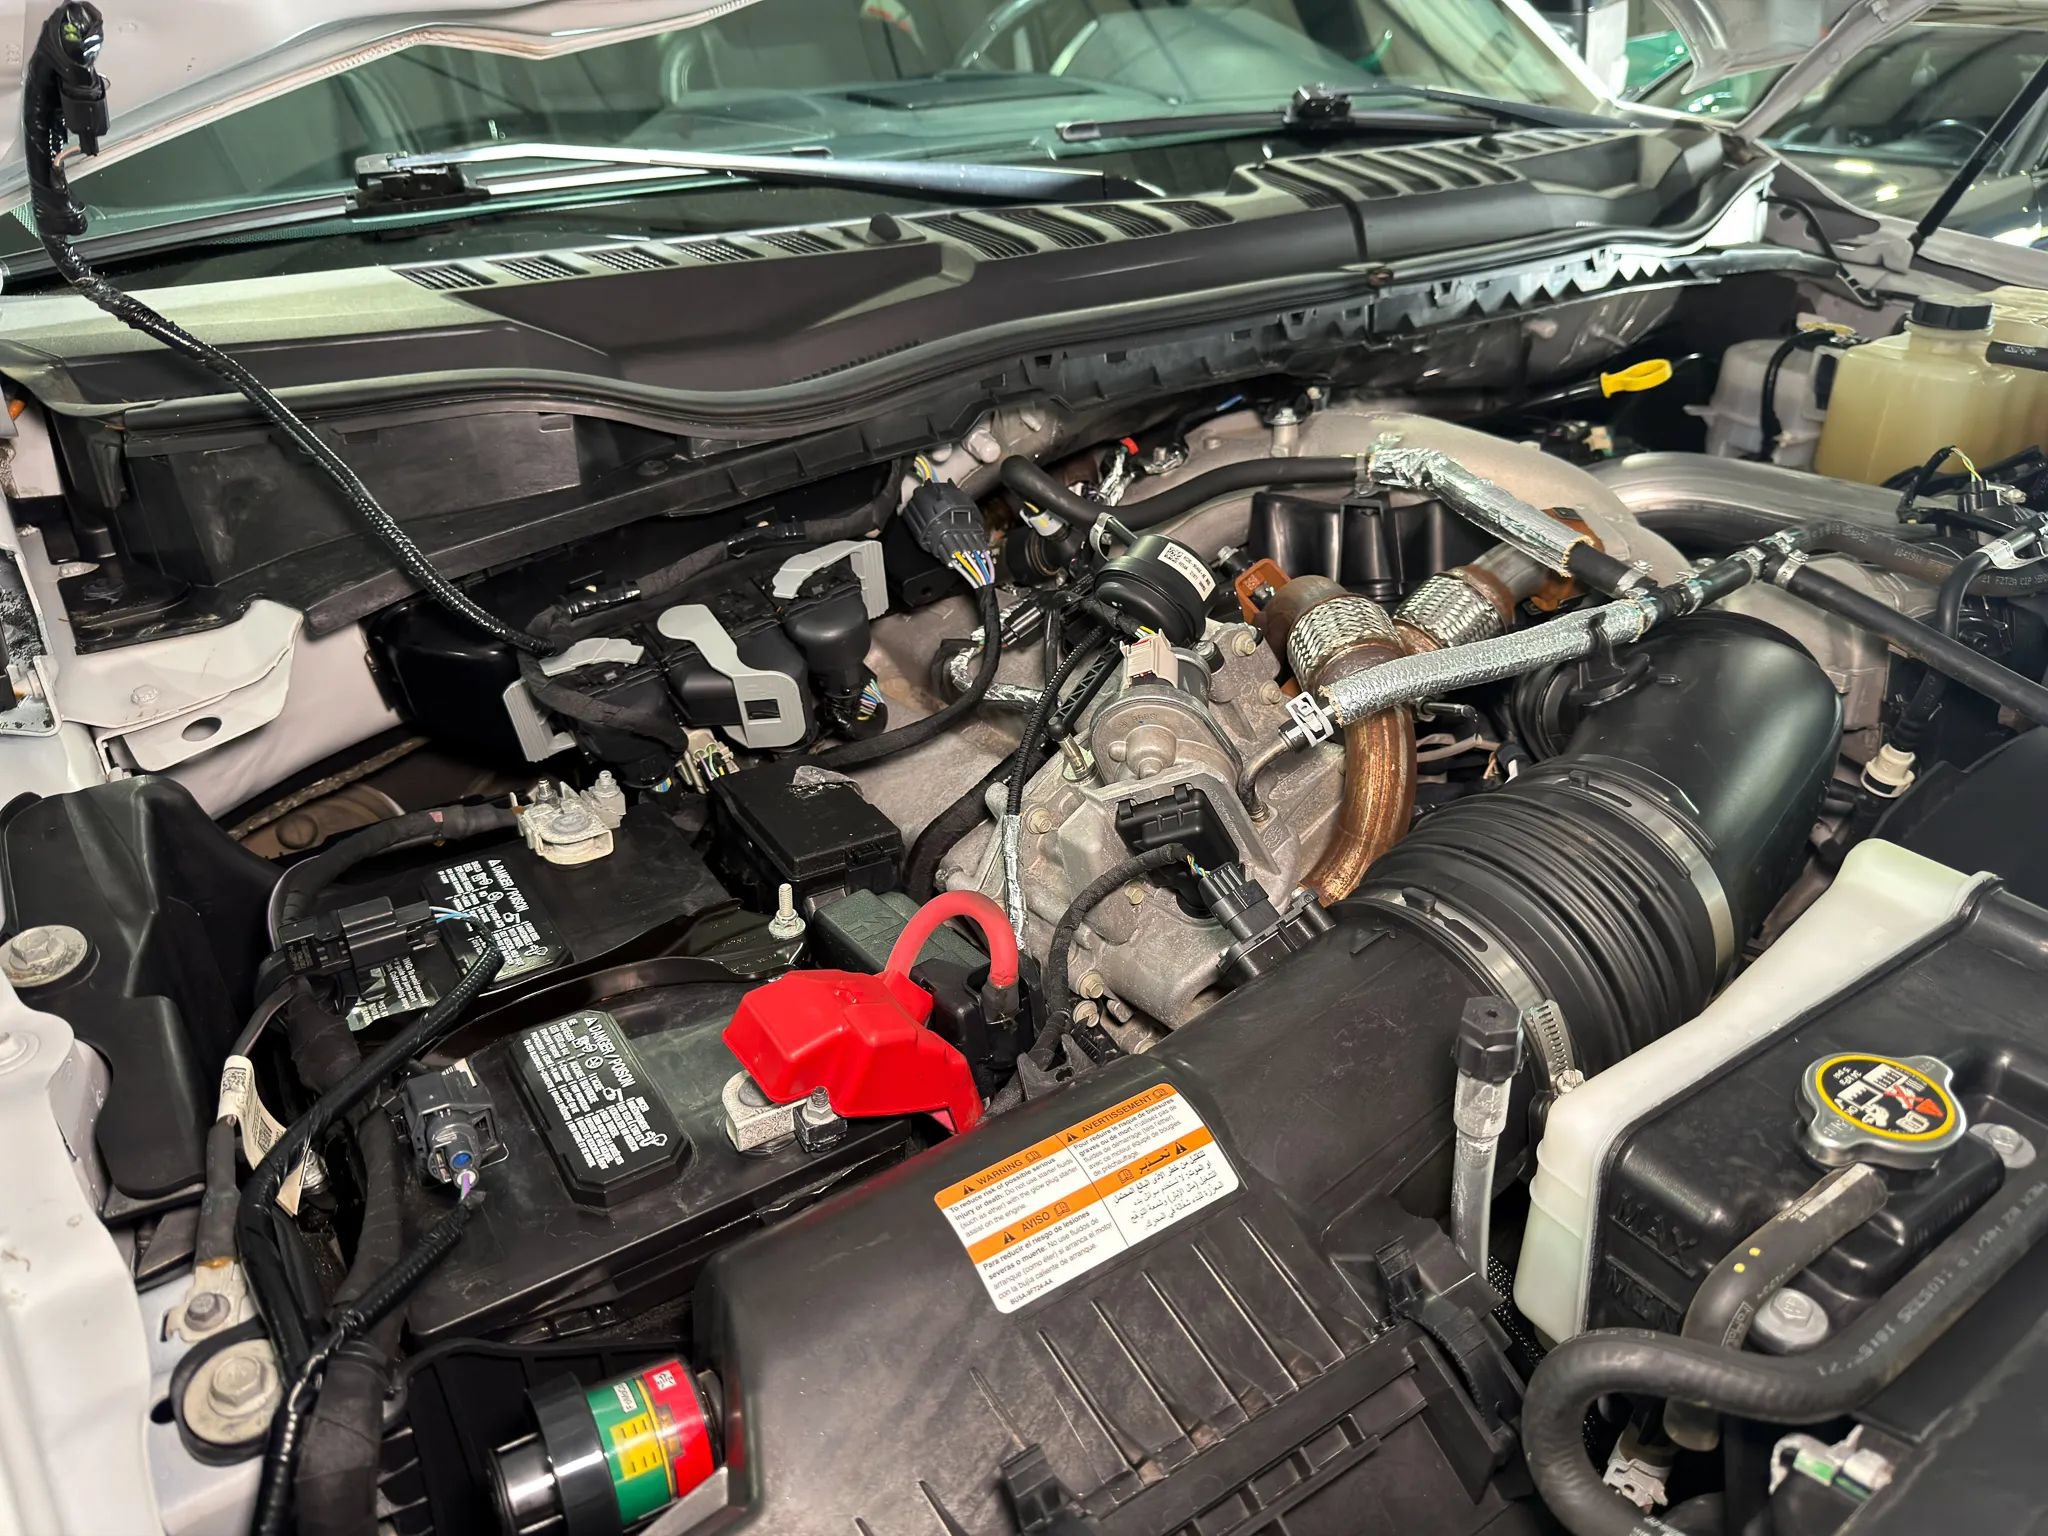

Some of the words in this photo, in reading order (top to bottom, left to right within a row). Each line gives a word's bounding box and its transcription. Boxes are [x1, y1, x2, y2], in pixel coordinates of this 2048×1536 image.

[1073, 1140, 1089, 1150] Pour
[1118, 1116, 1137, 1128] risque
[1145, 1098, 1174, 1114] blessures
[1081, 1094, 1152, 1133] AVERTISSEMENT
[976, 1159, 1024, 1185] WARNING
[1079, 1143, 1100, 1157] graves
[954, 1208, 975, 1221] injury
[1004, 1188, 1015, 1196] Do
[1014, 1182, 1026, 1191] not
[1026, 1177, 1038, 1185] use
[1037, 1166, 1057, 1179] starter
[1056, 1158, 1073, 1169] fluids
[959, 1195, 983, 1208] reduce
[983, 1188, 996, 1196] risk
[1004, 1170, 1032, 1187] possible
[1032, 1158, 1056, 1172] serious
[960, 1217, 979, 1230] (such
[987, 1202, 1006, 1215] ether)
[1006, 1196, 1020, 1205] with
[1019, 1191, 1031, 1199] the
[1030, 1183, 1045, 1195] glow
[1045, 1176, 1059, 1187] plug
[1058, 1166, 1078, 1179] starter
[965, 1224, 985, 1238] assist
[984, 1220, 994, 1228] on
[993, 1214, 1004, 1223] the
[982, 1259, 1000, 1270] Para
[1000, 1245, 1024, 1261] reducir
[1032, 1230, 1053, 1244] riesgo
[1062, 1211, 1090, 1228] lesiones
[1021, 1211, 1051, 1233] AVISO
[988, 1263, 1015, 1280] severas
[1047, 1240, 1058, 1248] No
[1058, 1234, 1070, 1243] use
[1069, 1223, 1091, 1236] fluidos
[1090, 1217, 1099, 1226] de
[993, 1271, 1022, 1290] arranque
[1022, 1260, 1043, 1275] (como
[1065, 1236, 1089, 1251] arranca
[1095, 1222, 1112, 1235] motor
[998, 1289, 1011, 1300] con
[1035, 1263, 1060, 1280] caliente
[1059, 1258, 1068, 1266] de
